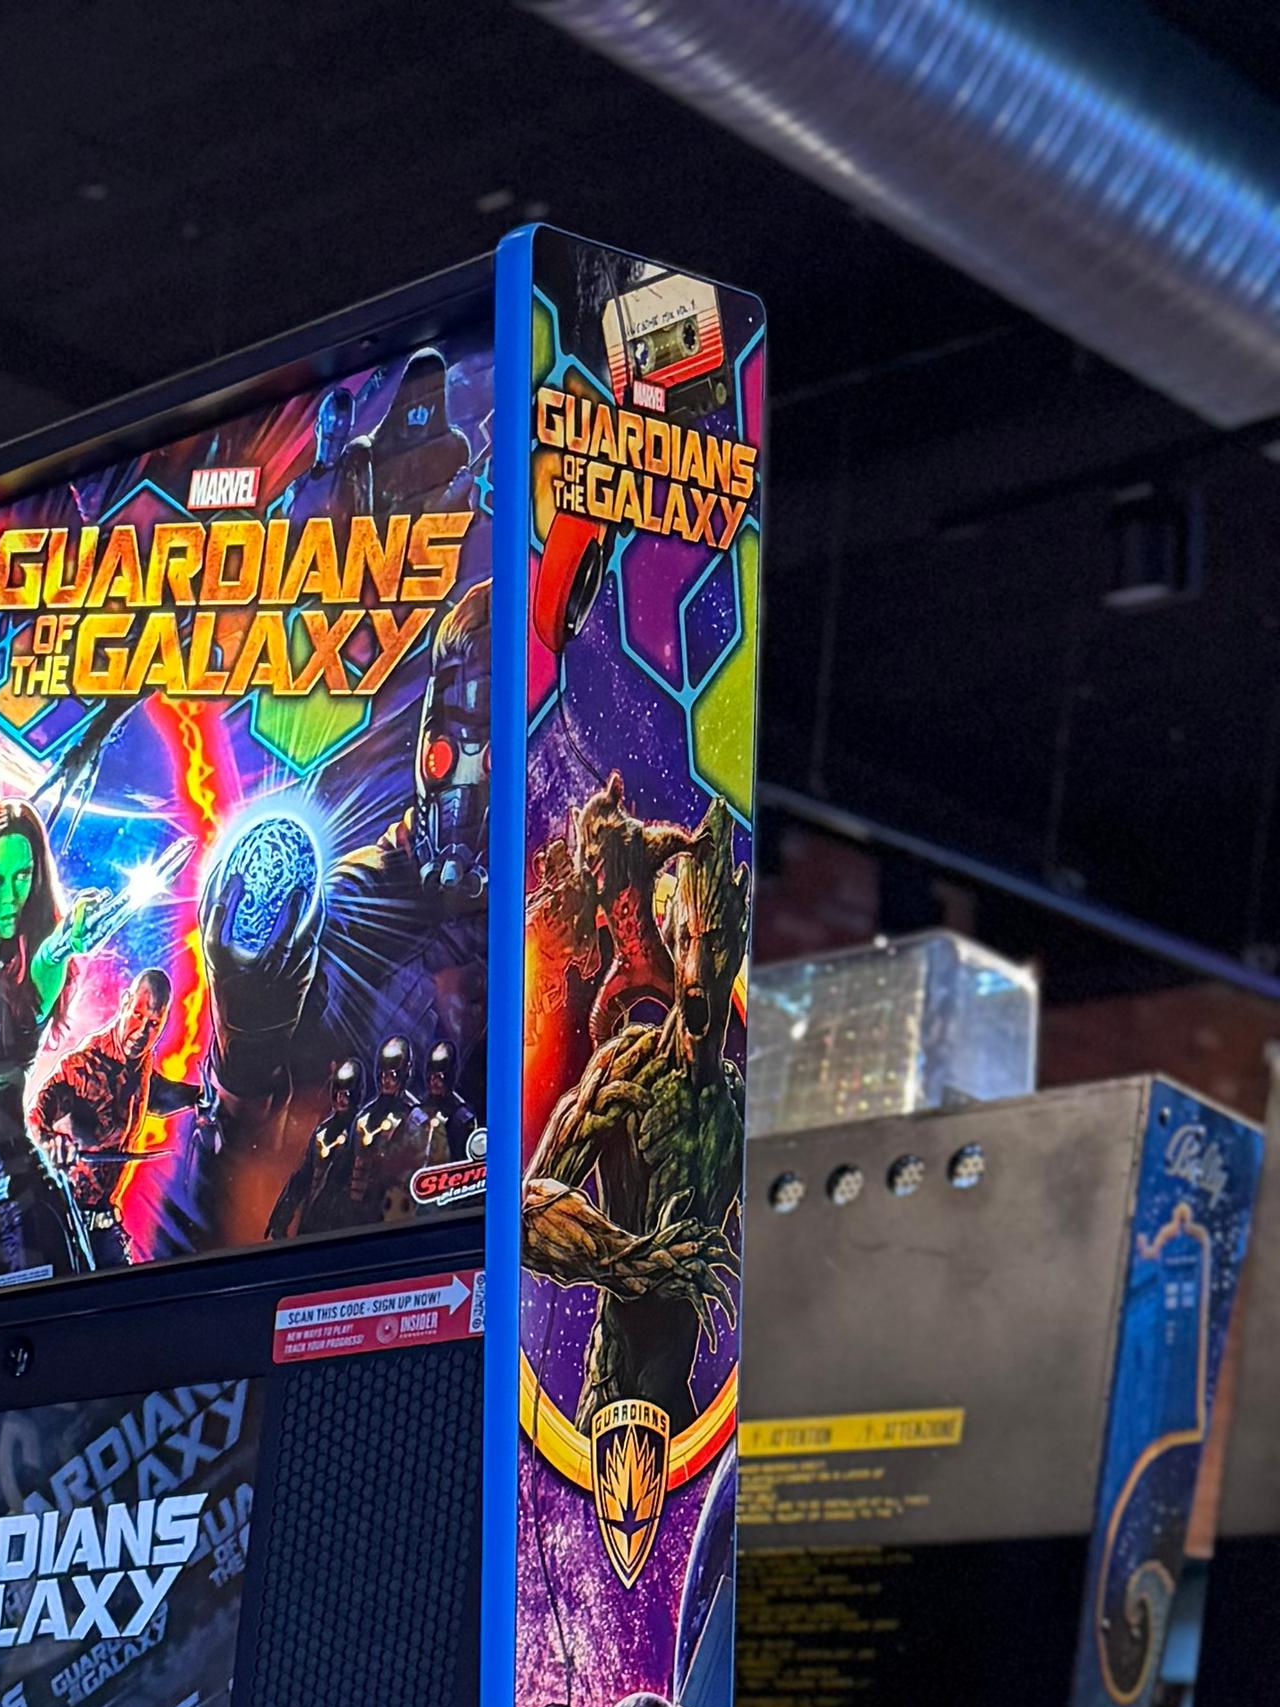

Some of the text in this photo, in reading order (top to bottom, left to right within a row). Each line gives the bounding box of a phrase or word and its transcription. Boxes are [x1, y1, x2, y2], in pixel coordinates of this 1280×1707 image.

[536, 386, 757, 499] GUARDIANS
[564, 454, 588, 484] OF
[189, 469, 259, 508] MARVEL
[554, 461, 747, 550] THE GALAXY
[32, 615, 78, 655] OF
[10, 608, 435, 697] THE GALAXY
[419, 1160, 487, 1194] Stern
[288, 1310, 314, 1326] SCAN
[316, 1307, 338, 1322] THIS
[340, 1304, 366, 1319] CODE
[372, 1298, 396, 1313] SIGN
[397, 1296, 413, 1310] UP
[413, 1291, 442, 1307] NOW!
[400, 1311, 438, 1333] INSIDER
[284, 1340, 305, 1354] TRACK
[306, 1337, 326, 1351] YOUR
[286, 1329, 304, 1342] NEW
[594, 1403, 667, 1434] GUARDIANS
